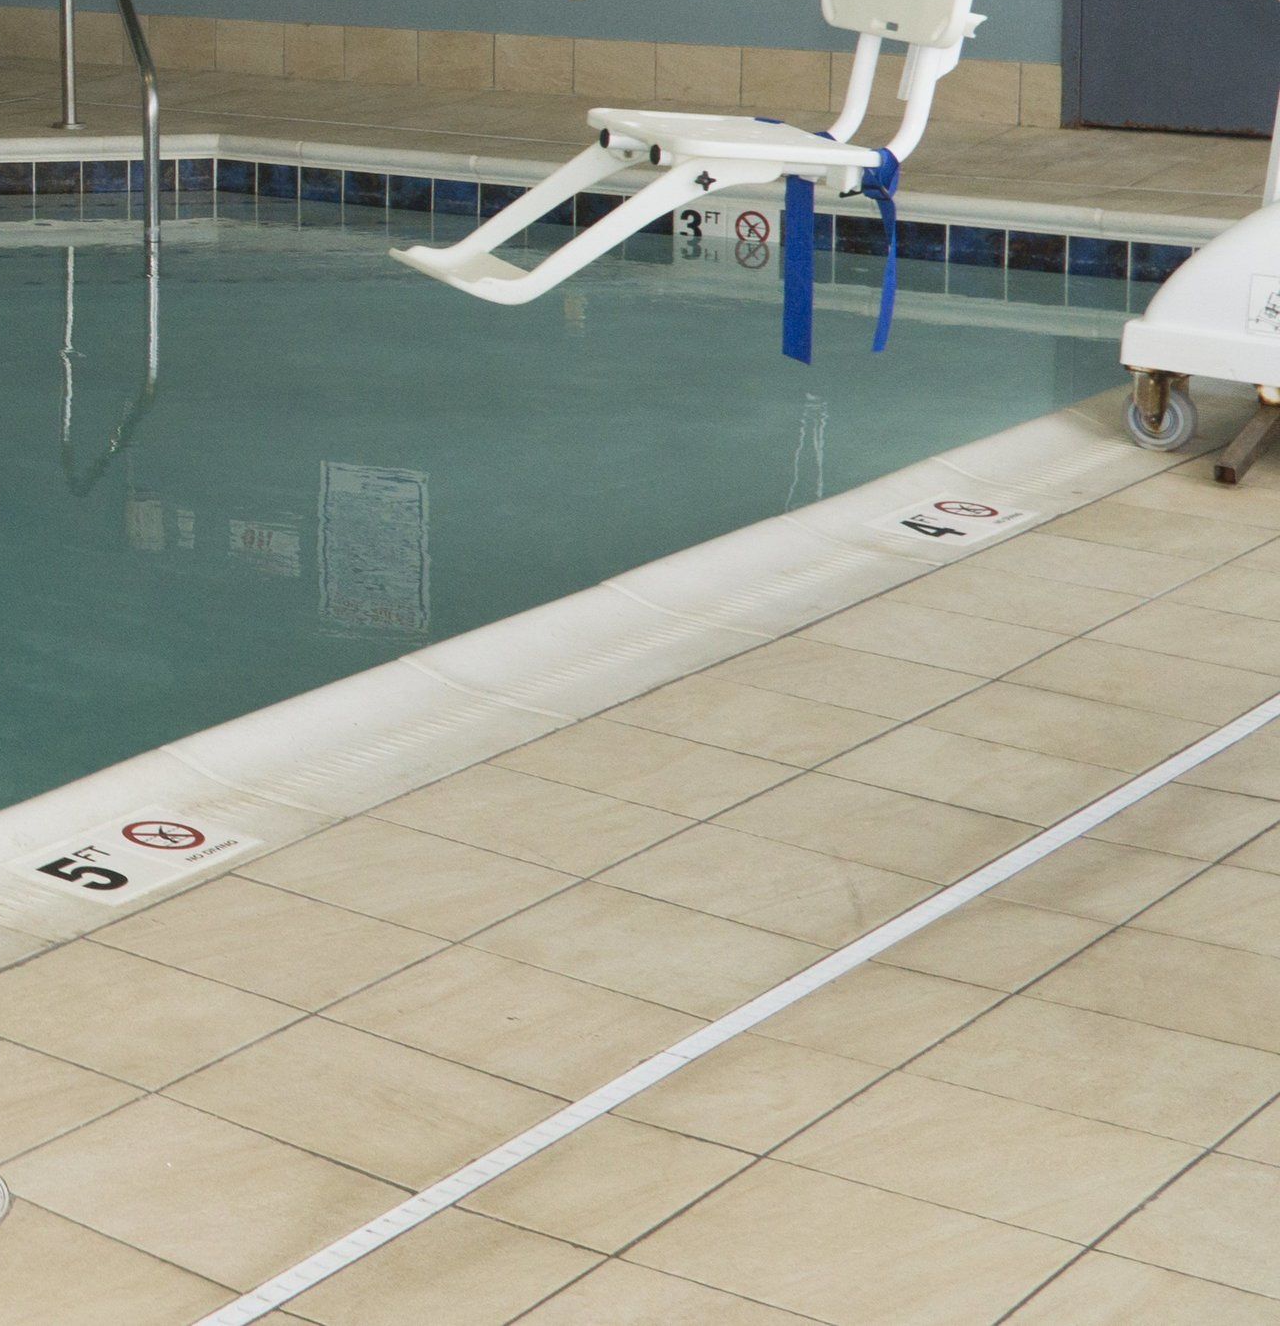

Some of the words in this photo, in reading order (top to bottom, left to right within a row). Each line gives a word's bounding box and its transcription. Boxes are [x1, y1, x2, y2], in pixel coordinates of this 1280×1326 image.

[680, 210, 702, 237] 3
[704, 211, 721, 225] FT
[899, 519, 967, 538] 4
[71, 845, 112, 862] FT
[185, 853, 204, 862] NO
[202, 839, 239, 856] DIVING
[35, 857, 128, 891] 5
